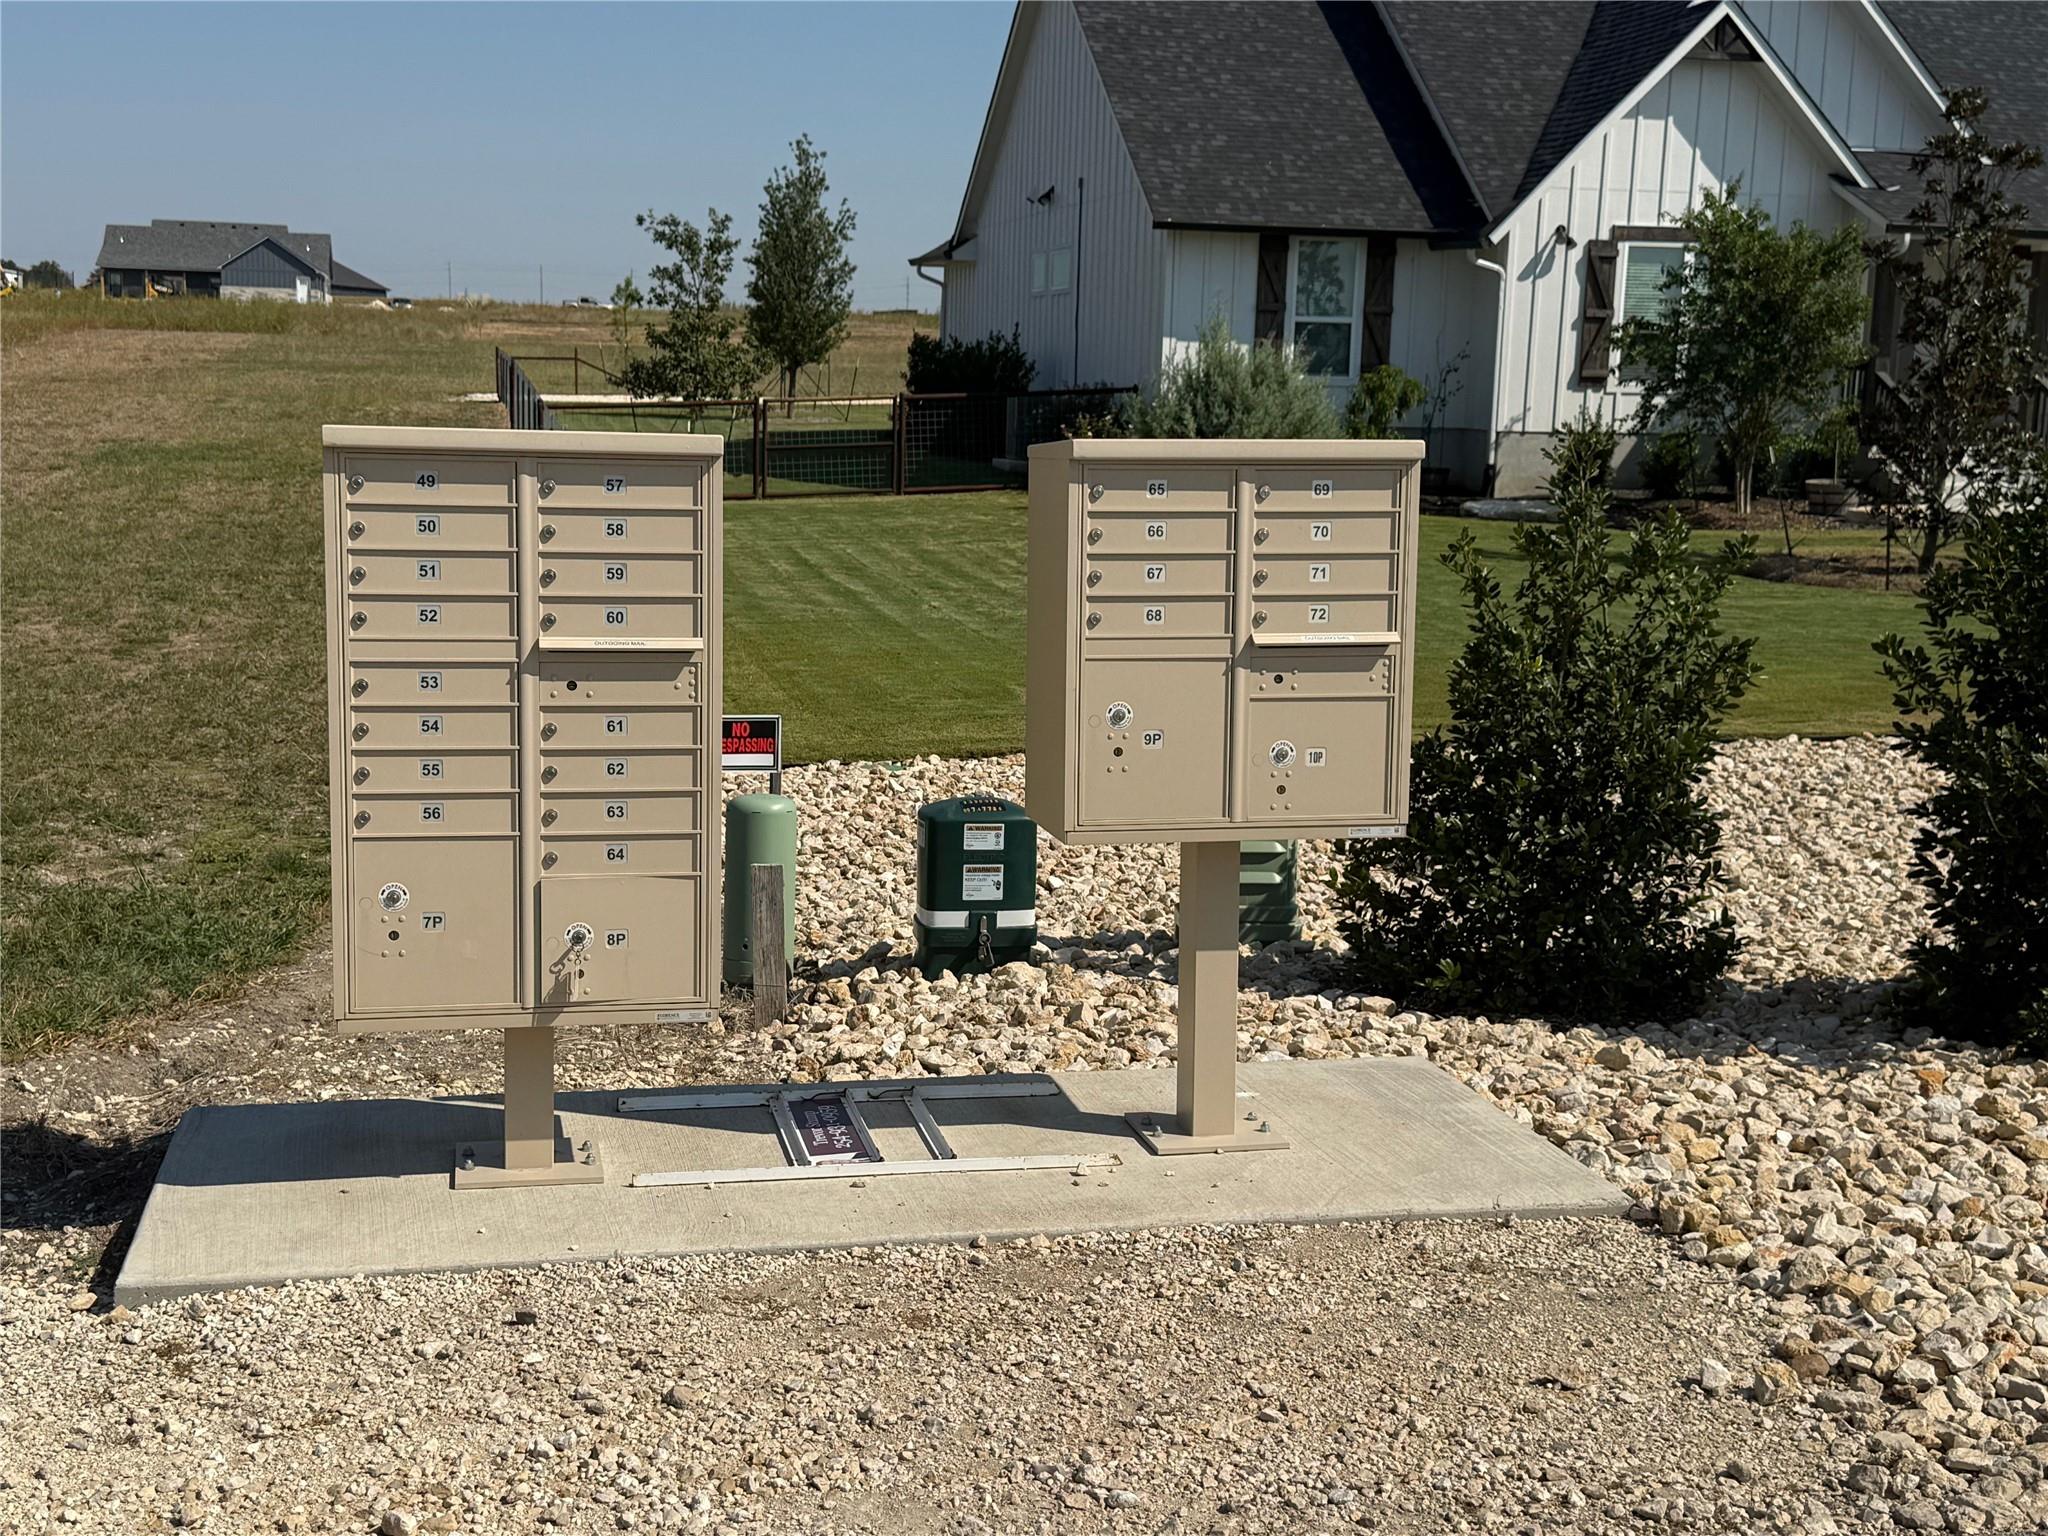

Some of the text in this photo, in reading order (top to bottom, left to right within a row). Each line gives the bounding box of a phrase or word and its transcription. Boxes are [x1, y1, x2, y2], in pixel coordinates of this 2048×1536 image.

[418, 475, 435, 488] 49
[606, 479, 624, 492] 57
[1149, 483, 1165, 495] 65
[1314, 483, 1330, 495] 69
[419, 520, 436, 532] 50
[607, 523, 624, 536] 58
[1148, 525, 1164, 537] 66
[1313, 525, 1329, 538] 70
[419, 565, 436, 577] 51
[607, 567, 624, 580] 59
[1147, 567, 1163, 579] 67
[1312, 567, 1326, 579] 71
[420, 610, 437, 622] 52
[607, 611, 624, 624] 60
[1146, 610, 1162, 622] 68
[1311, 609, 1327, 621] 72
[421, 676, 438, 688] 53
[422, 720, 439, 732] 54
[607, 720, 623, 732] 61
[732, 721, 750, 737] NO
[722, 737, 774, 752] ESPASSING
[1144, 733, 1162, 745] 9P
[1309, 751, 1323, 764] 10P
[422, 763, 440, 776] 55
[607, 763, 624, 775] 62
[423, 807, 440, 819] 56
[607, 806, 624, 818] 63
[607, 848, 624, 860] 64
[423, 916, 442, 928] 7P
[607, 934, 626, 946] 8P
